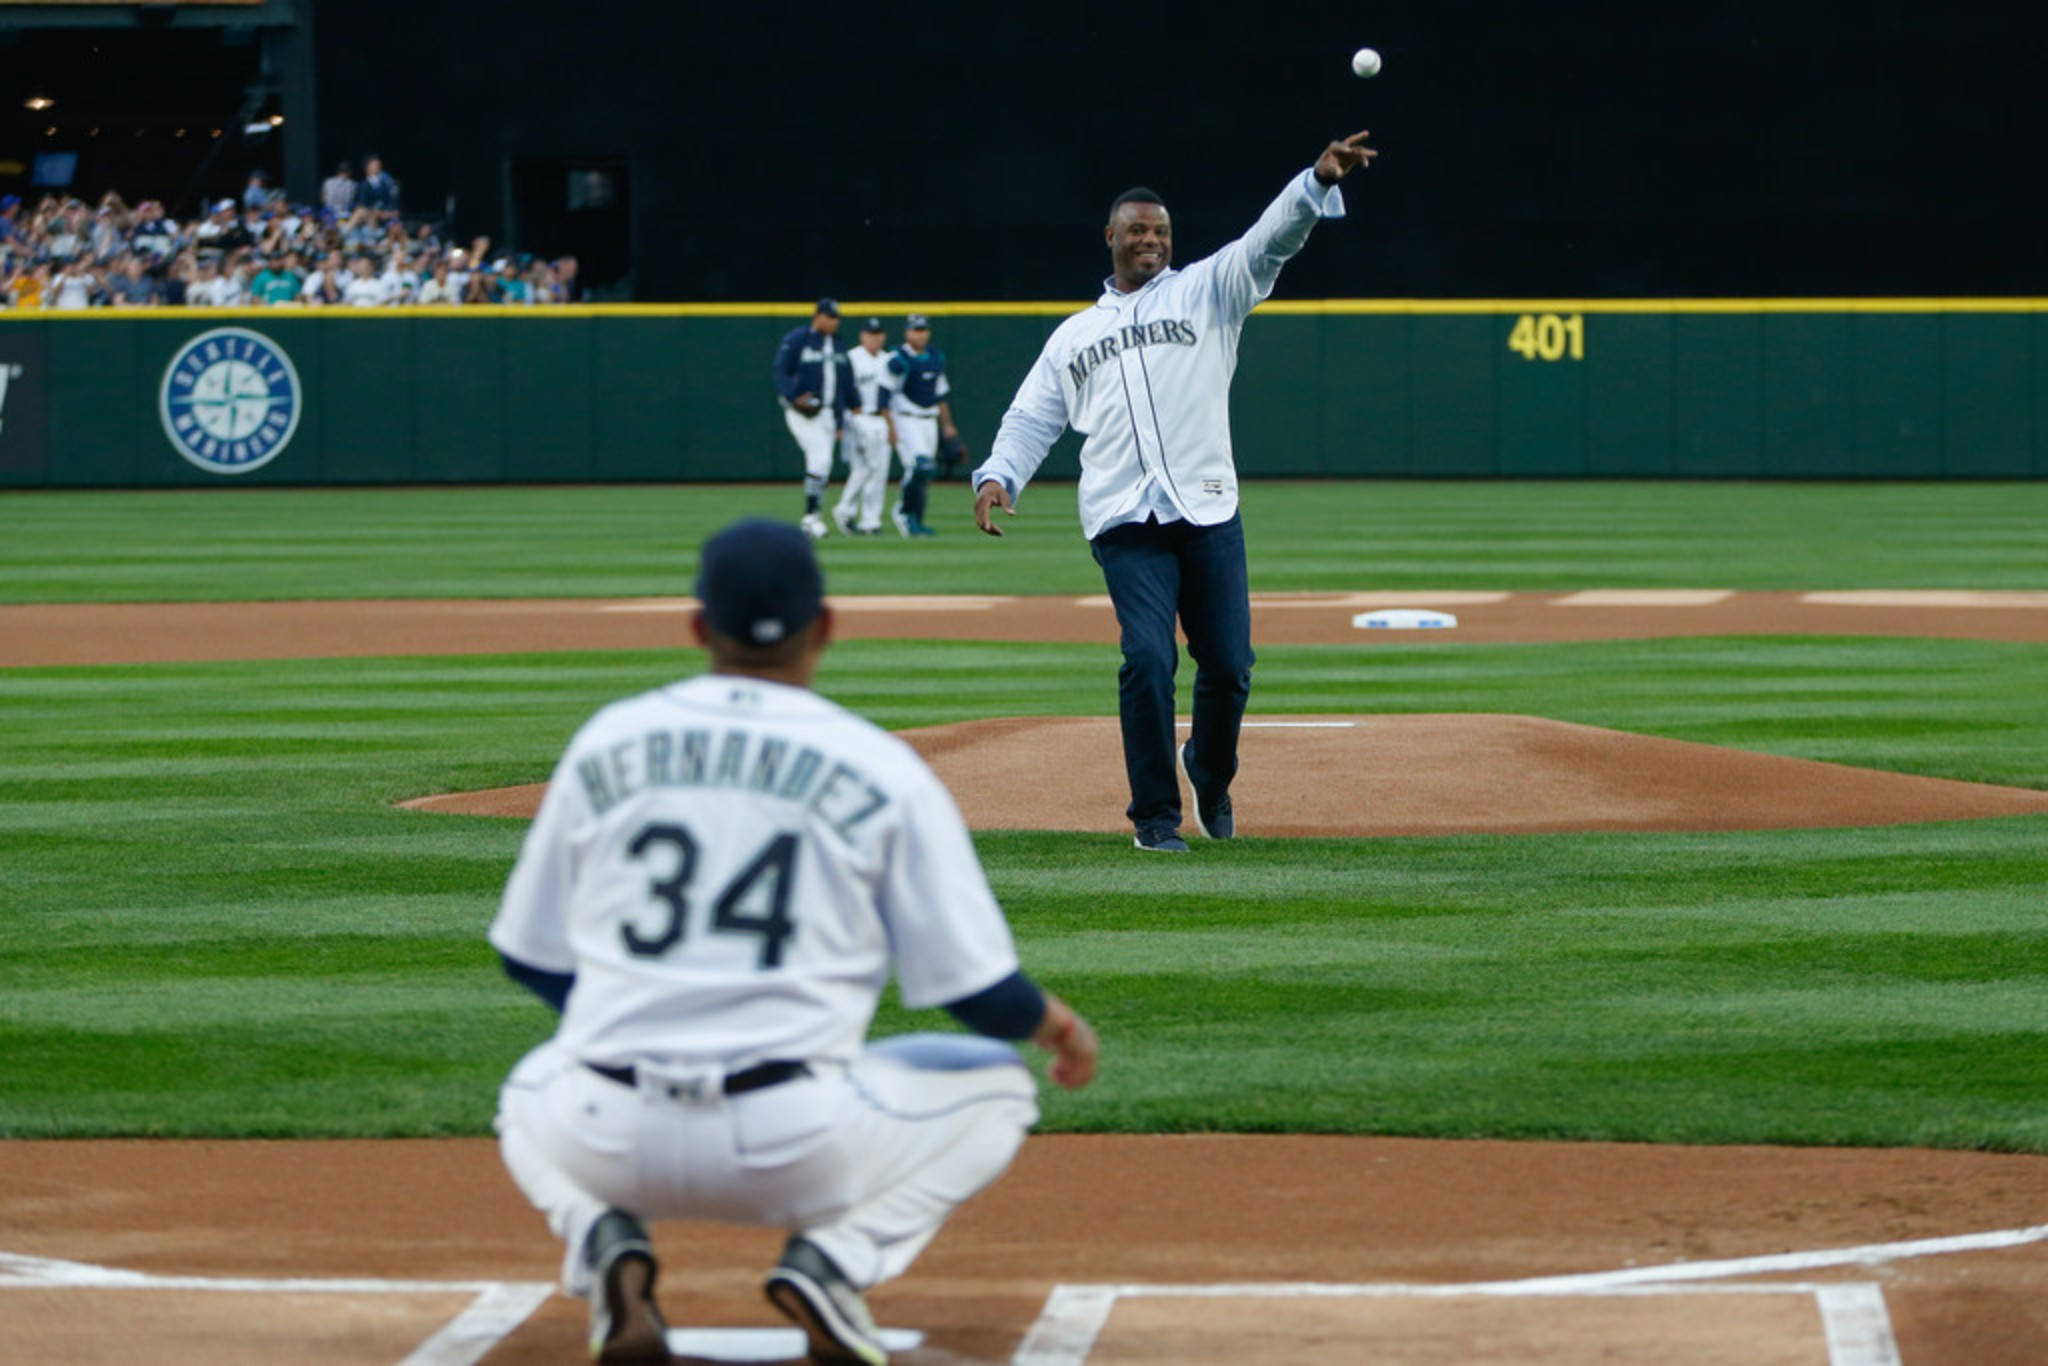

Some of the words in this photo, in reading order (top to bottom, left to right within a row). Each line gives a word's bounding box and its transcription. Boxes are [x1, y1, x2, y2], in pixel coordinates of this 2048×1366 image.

[1067, 319, 1197, 391] MARINERS
[1508, 314, 1584, 361] 401
[577, 729, 890, 843] HERNANDEZ
[619, 821, 802, 971] 34
